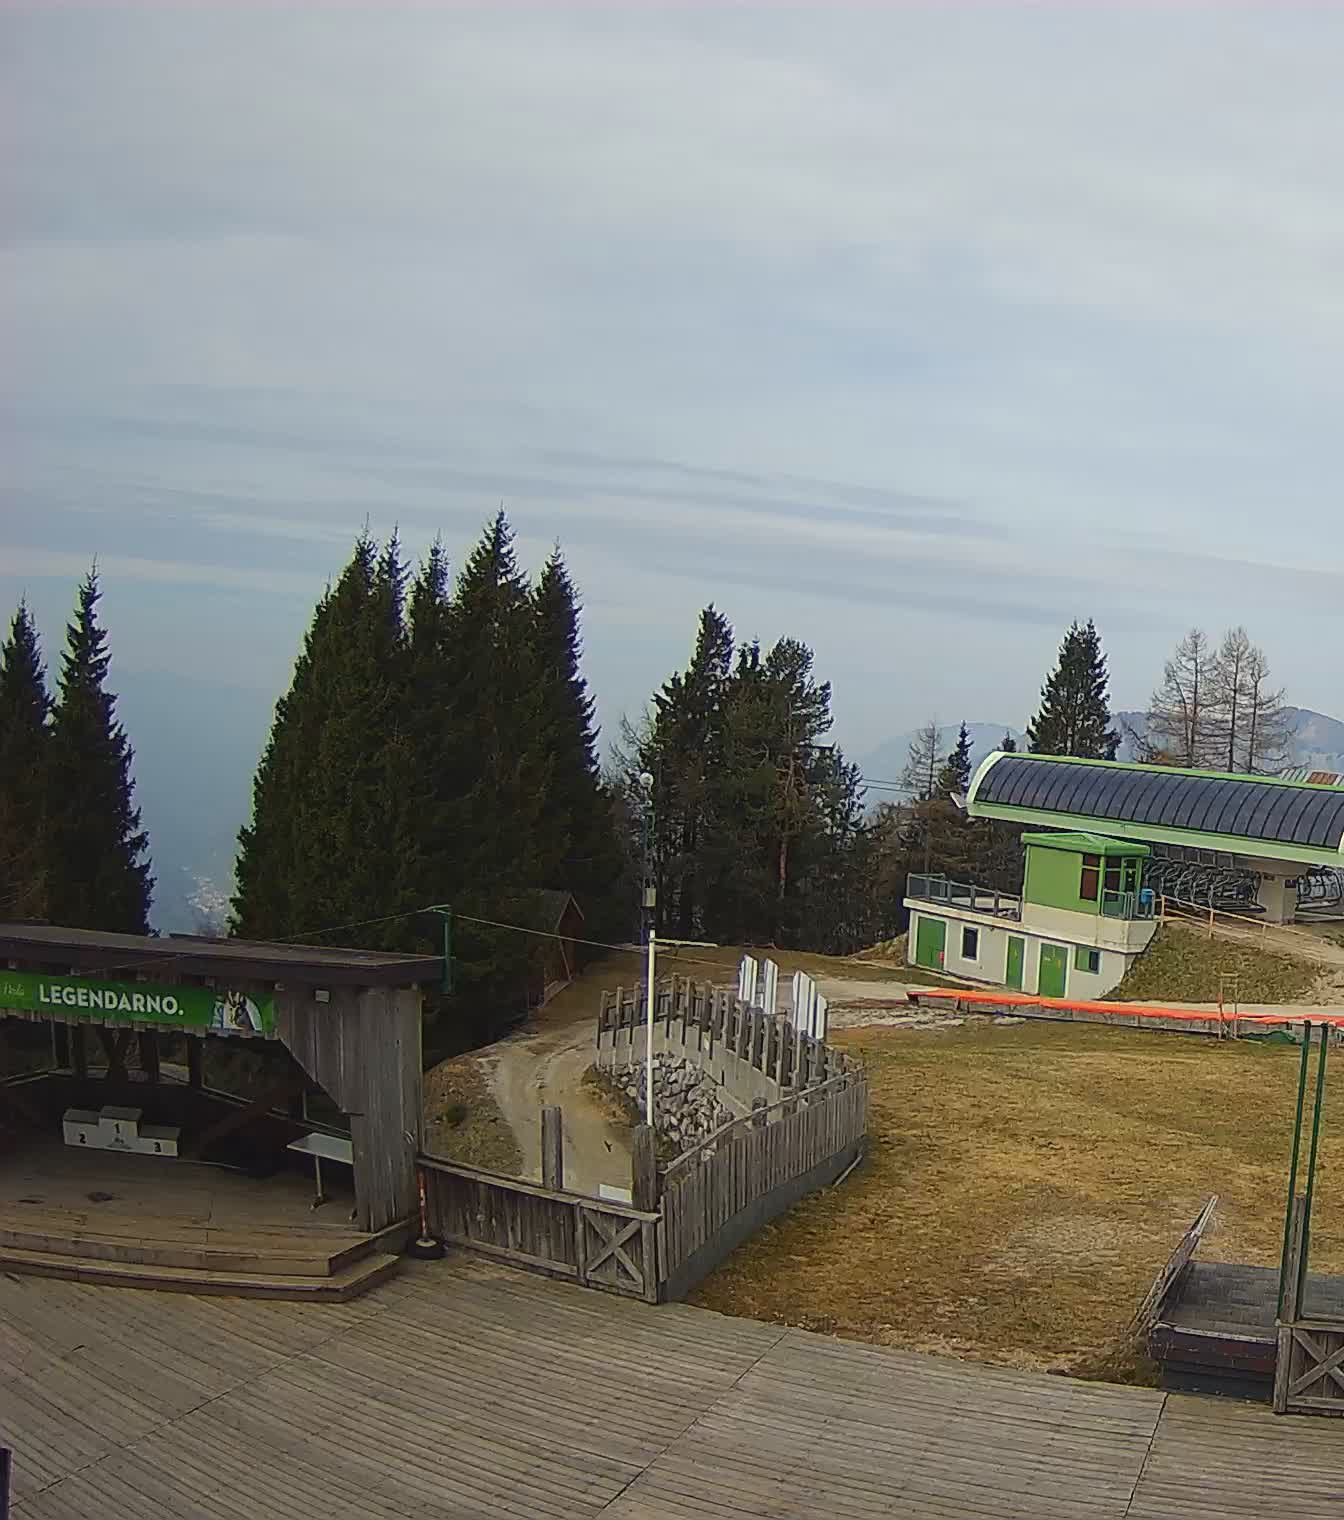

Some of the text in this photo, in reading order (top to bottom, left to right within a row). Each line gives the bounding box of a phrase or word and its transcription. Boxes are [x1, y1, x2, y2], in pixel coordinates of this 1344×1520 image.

[38, 983, 185, 1016] LEGENDARNO.
[114, 1123, 121, 1134] 1
[79, 1133, 87, 1144] 2
[154, 1142, 162, 1153] 3
